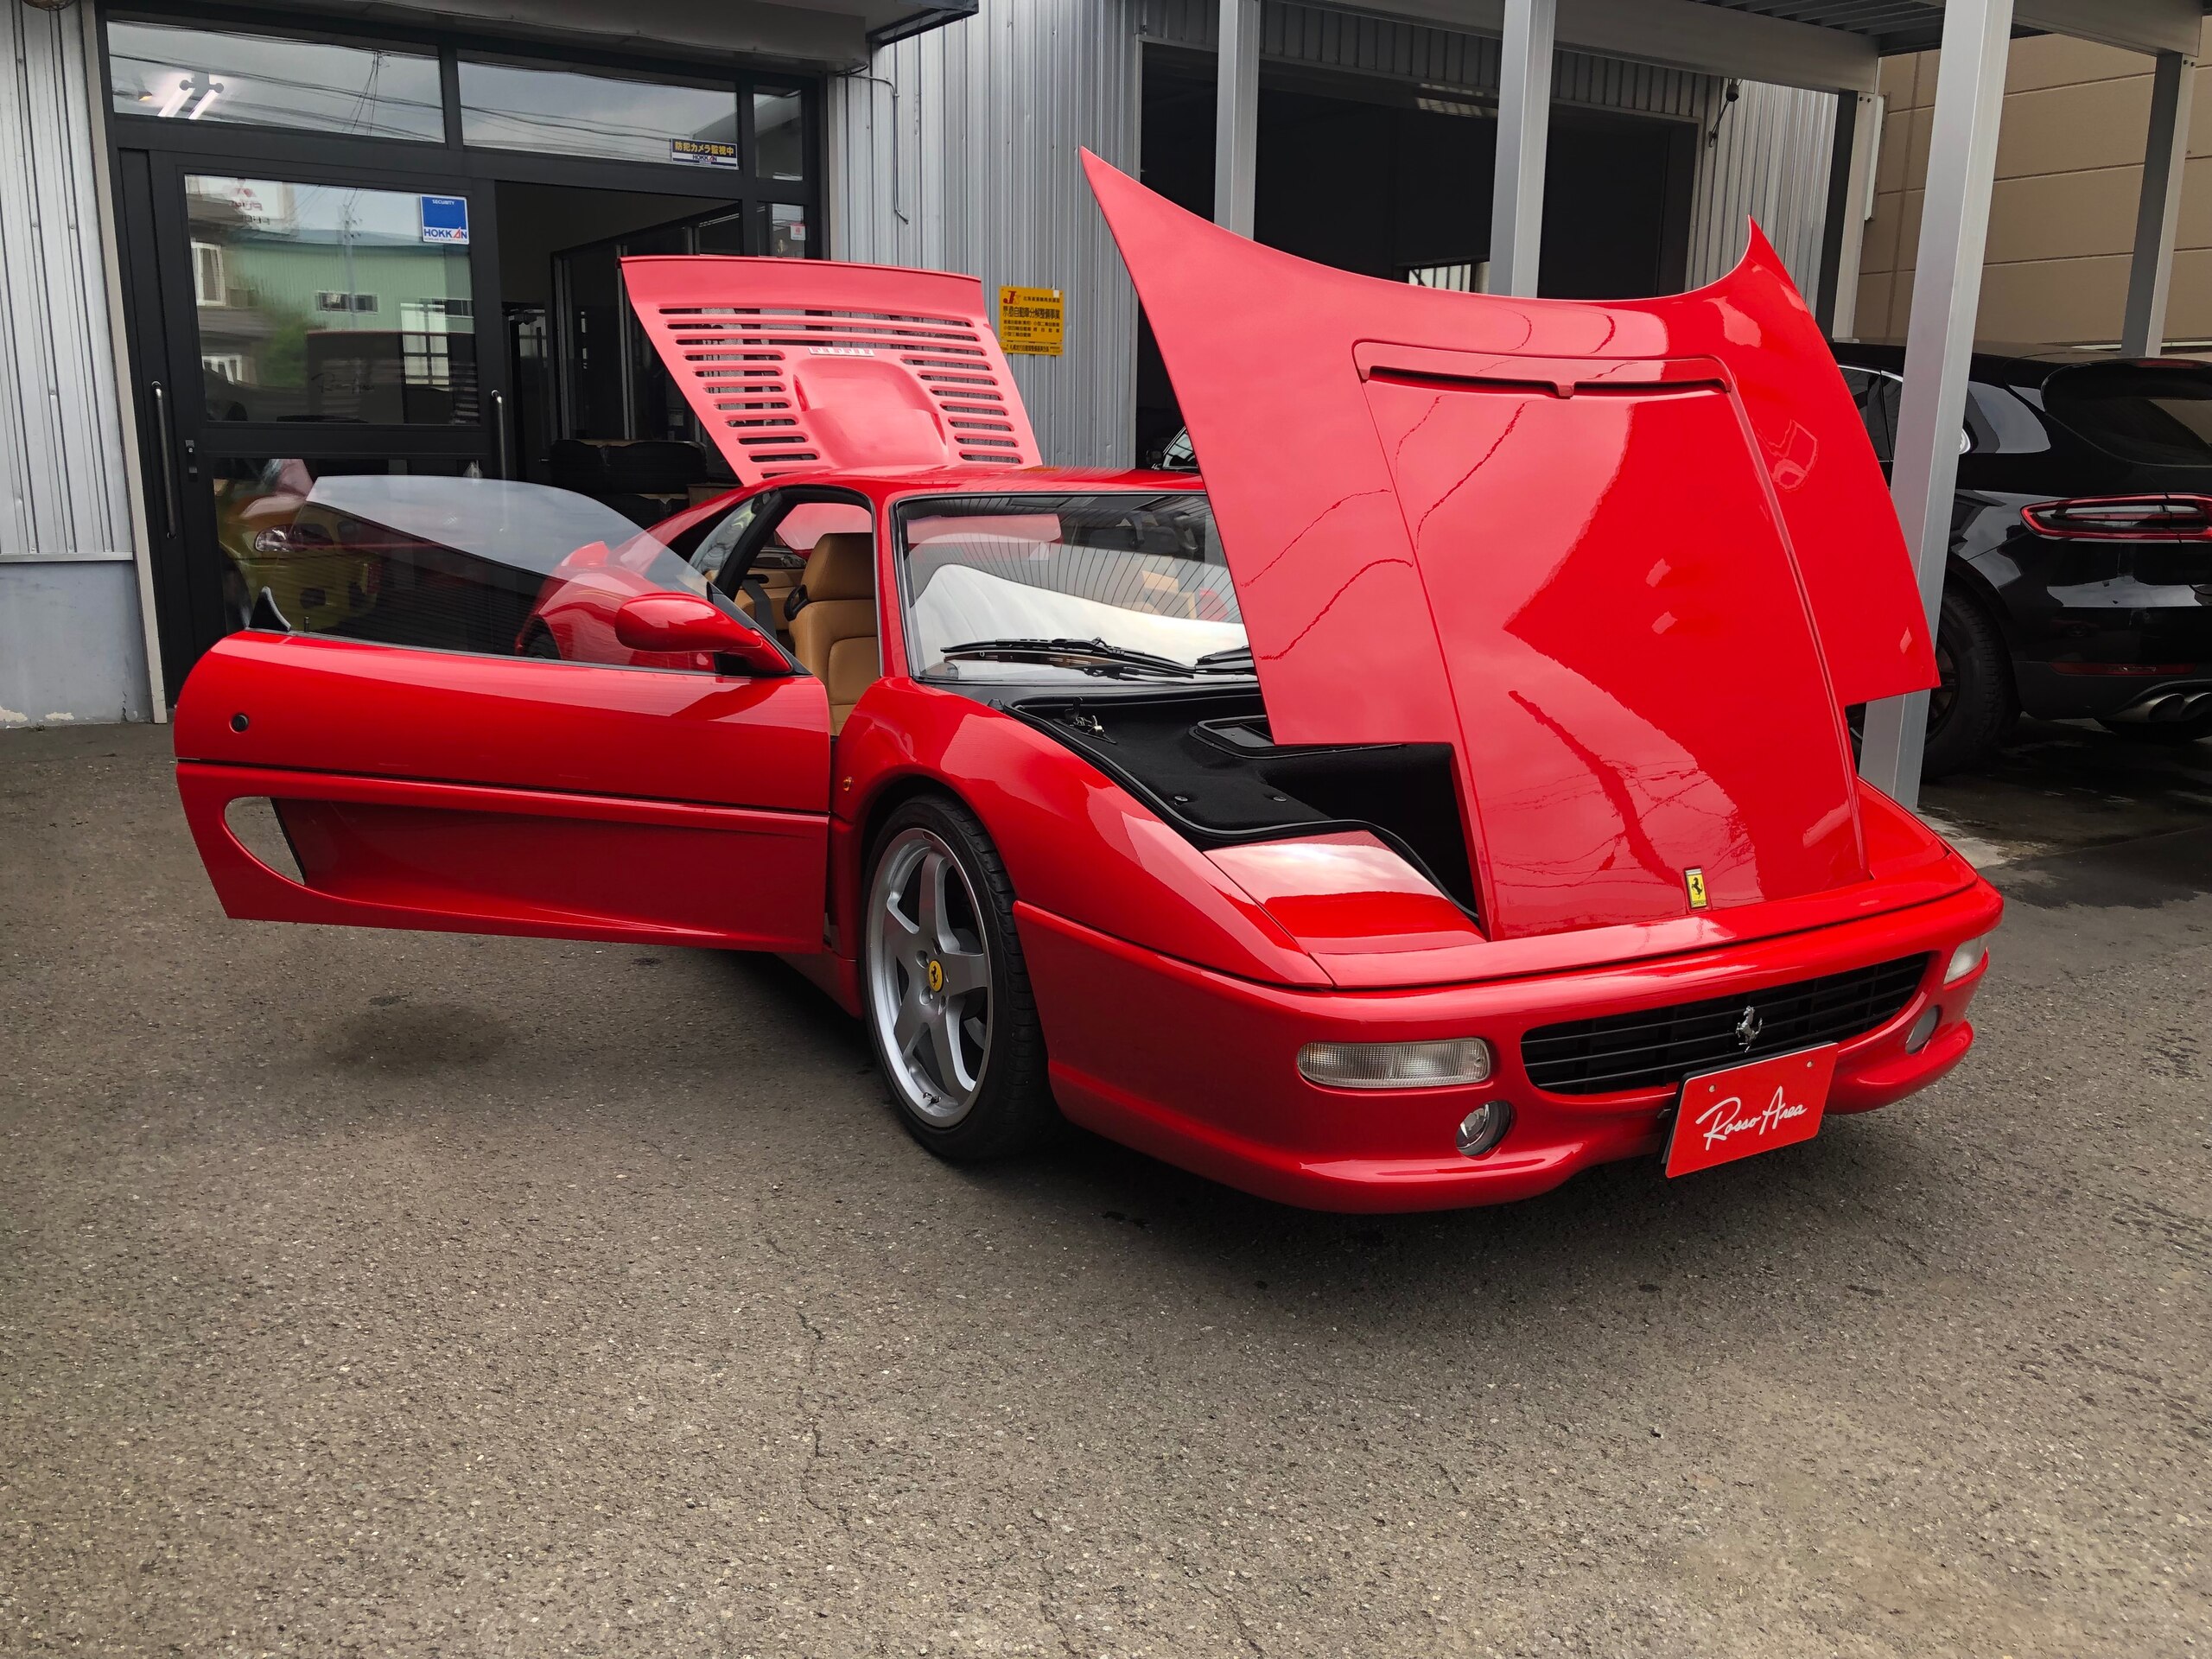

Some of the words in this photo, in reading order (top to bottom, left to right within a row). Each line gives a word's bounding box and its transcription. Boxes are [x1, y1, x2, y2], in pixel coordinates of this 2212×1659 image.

[675, 141, 734, 156] 防犯カメラ監視中
[424, 228, 467, 239] HOKKAN
[1695, 1096, 1762, 1151] Rosso
[1759, 1085, 1808, 1135] Area
